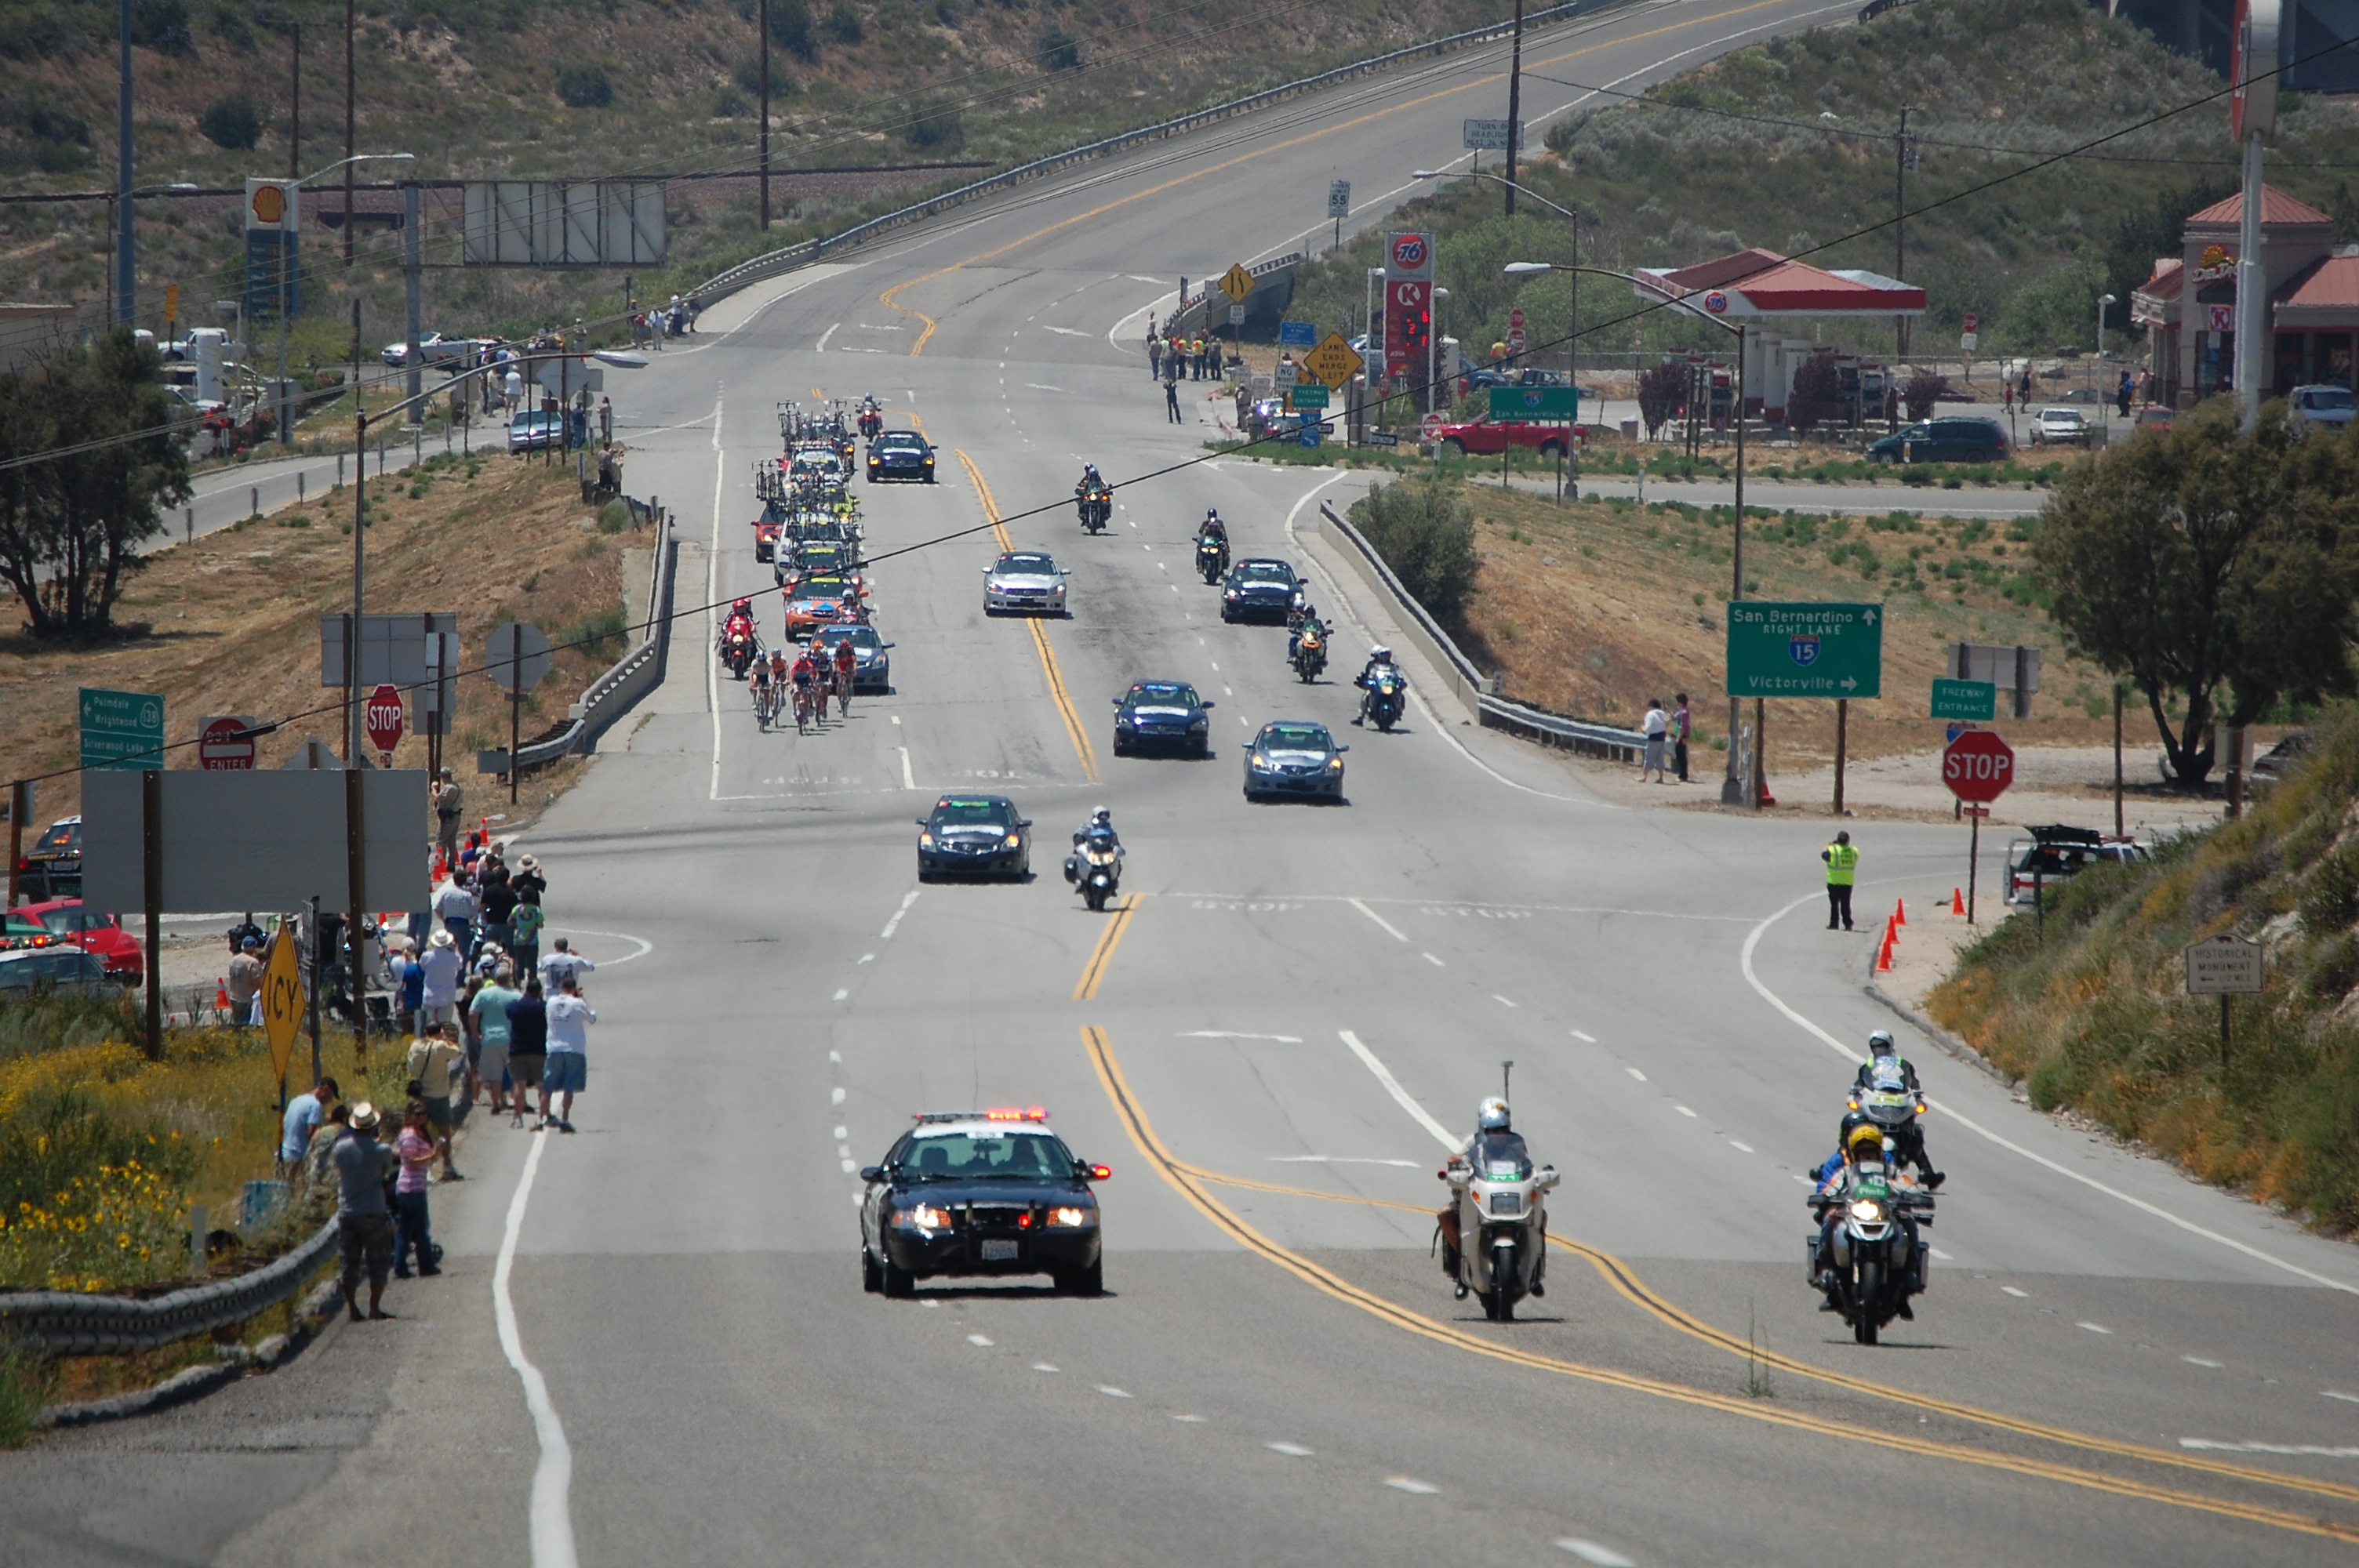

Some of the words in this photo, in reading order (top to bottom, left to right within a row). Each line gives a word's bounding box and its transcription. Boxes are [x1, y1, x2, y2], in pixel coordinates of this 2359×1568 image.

[1332, 194, 1347, 205] 55
[1398, 241, 1422, 262] 76
[1400, 284, 1419, 305] K
[1710, 296, 1725, 309] 76
[2212, 309, 2228, 329] K
[1530, 396, 1539, 405] 15
[1734, 609, 1764, 623] San
[1769, 609, 1853, 623] Bernardino
[1763, 624, 1802, 634] RIGHT
[1808, 625, 1842, 635] LANE
[1795, 644, 1815, 660] 15
[1749, 676, 1834, 690] Victorville
[1943, 687, 1986, 699] FREEWAY
[93, 696, 129, 710] Palmdale
[1938, 702, 1989, 713] ENTRANCE
[94, 714, 138, 728] Wrightwood
[144, 710, 157, 724] 138
[369, 706, 402, 731] STOP
[84, 738, 124, 752] Silverwood
[125, 740, 144, 753] Lake
[210, 759, 246, 771] ENTER
[1946, 753, 2010, 780] STOP
[2195, 948, 2253, 959] HISTORICAL
[2198, 962, 2252, 972] MONUMENT
[267, 972, 298, 1023] ICY
